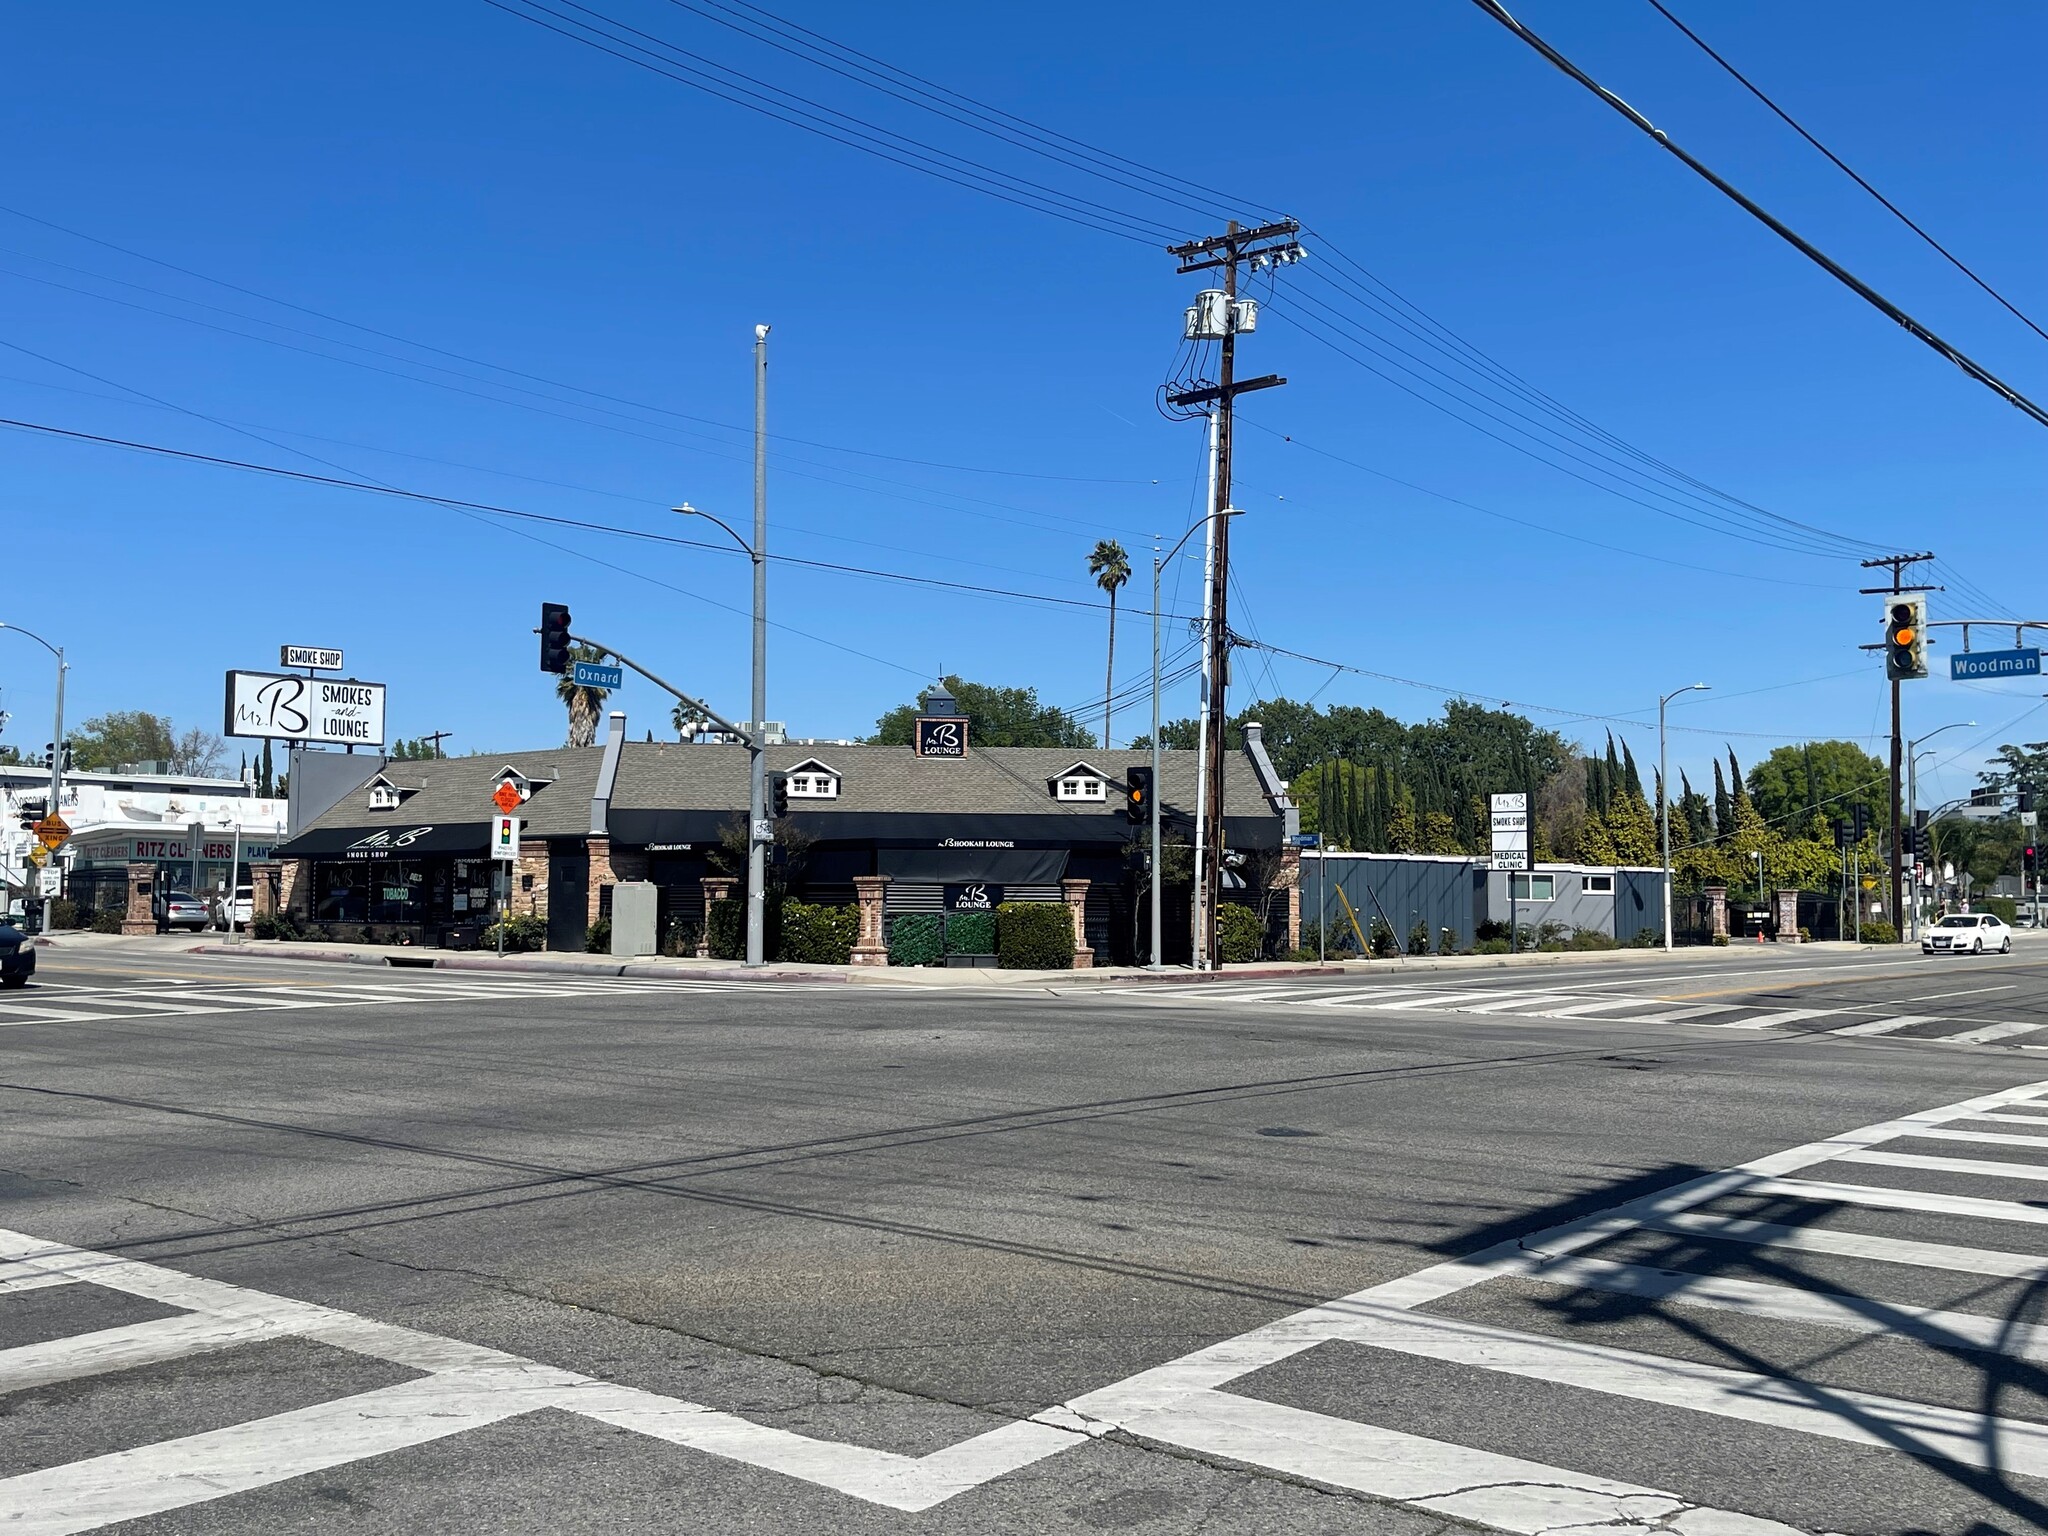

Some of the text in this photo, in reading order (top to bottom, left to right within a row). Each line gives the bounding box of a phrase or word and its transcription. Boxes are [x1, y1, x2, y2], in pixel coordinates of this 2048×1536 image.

[290, 649, 340, 666] SMOKE SHOP
[1955, 658, 2036, 674] Woodman
[578, 668, 618, 684] Oxnard
[322, 684, 372, 706] SMOKES
[256, 678, 308, 733] B
[324, 718, 369, 738] LOUNGE
[933, 724, 959, 746] B
[924, 746, 962, 755] LOUNGE
[1512, 794, 1525, 808] B
[1492, 816, 1526, 826] SMOKE SHOP
[392, 826, 433, 847] B
[100, 846, 128, 857] CLEANERS
[137, 841, 232, 858] RITZ CLNERS
[383, 888, 408, 900] TOBACCO
[966, 884, 988, 902] B
